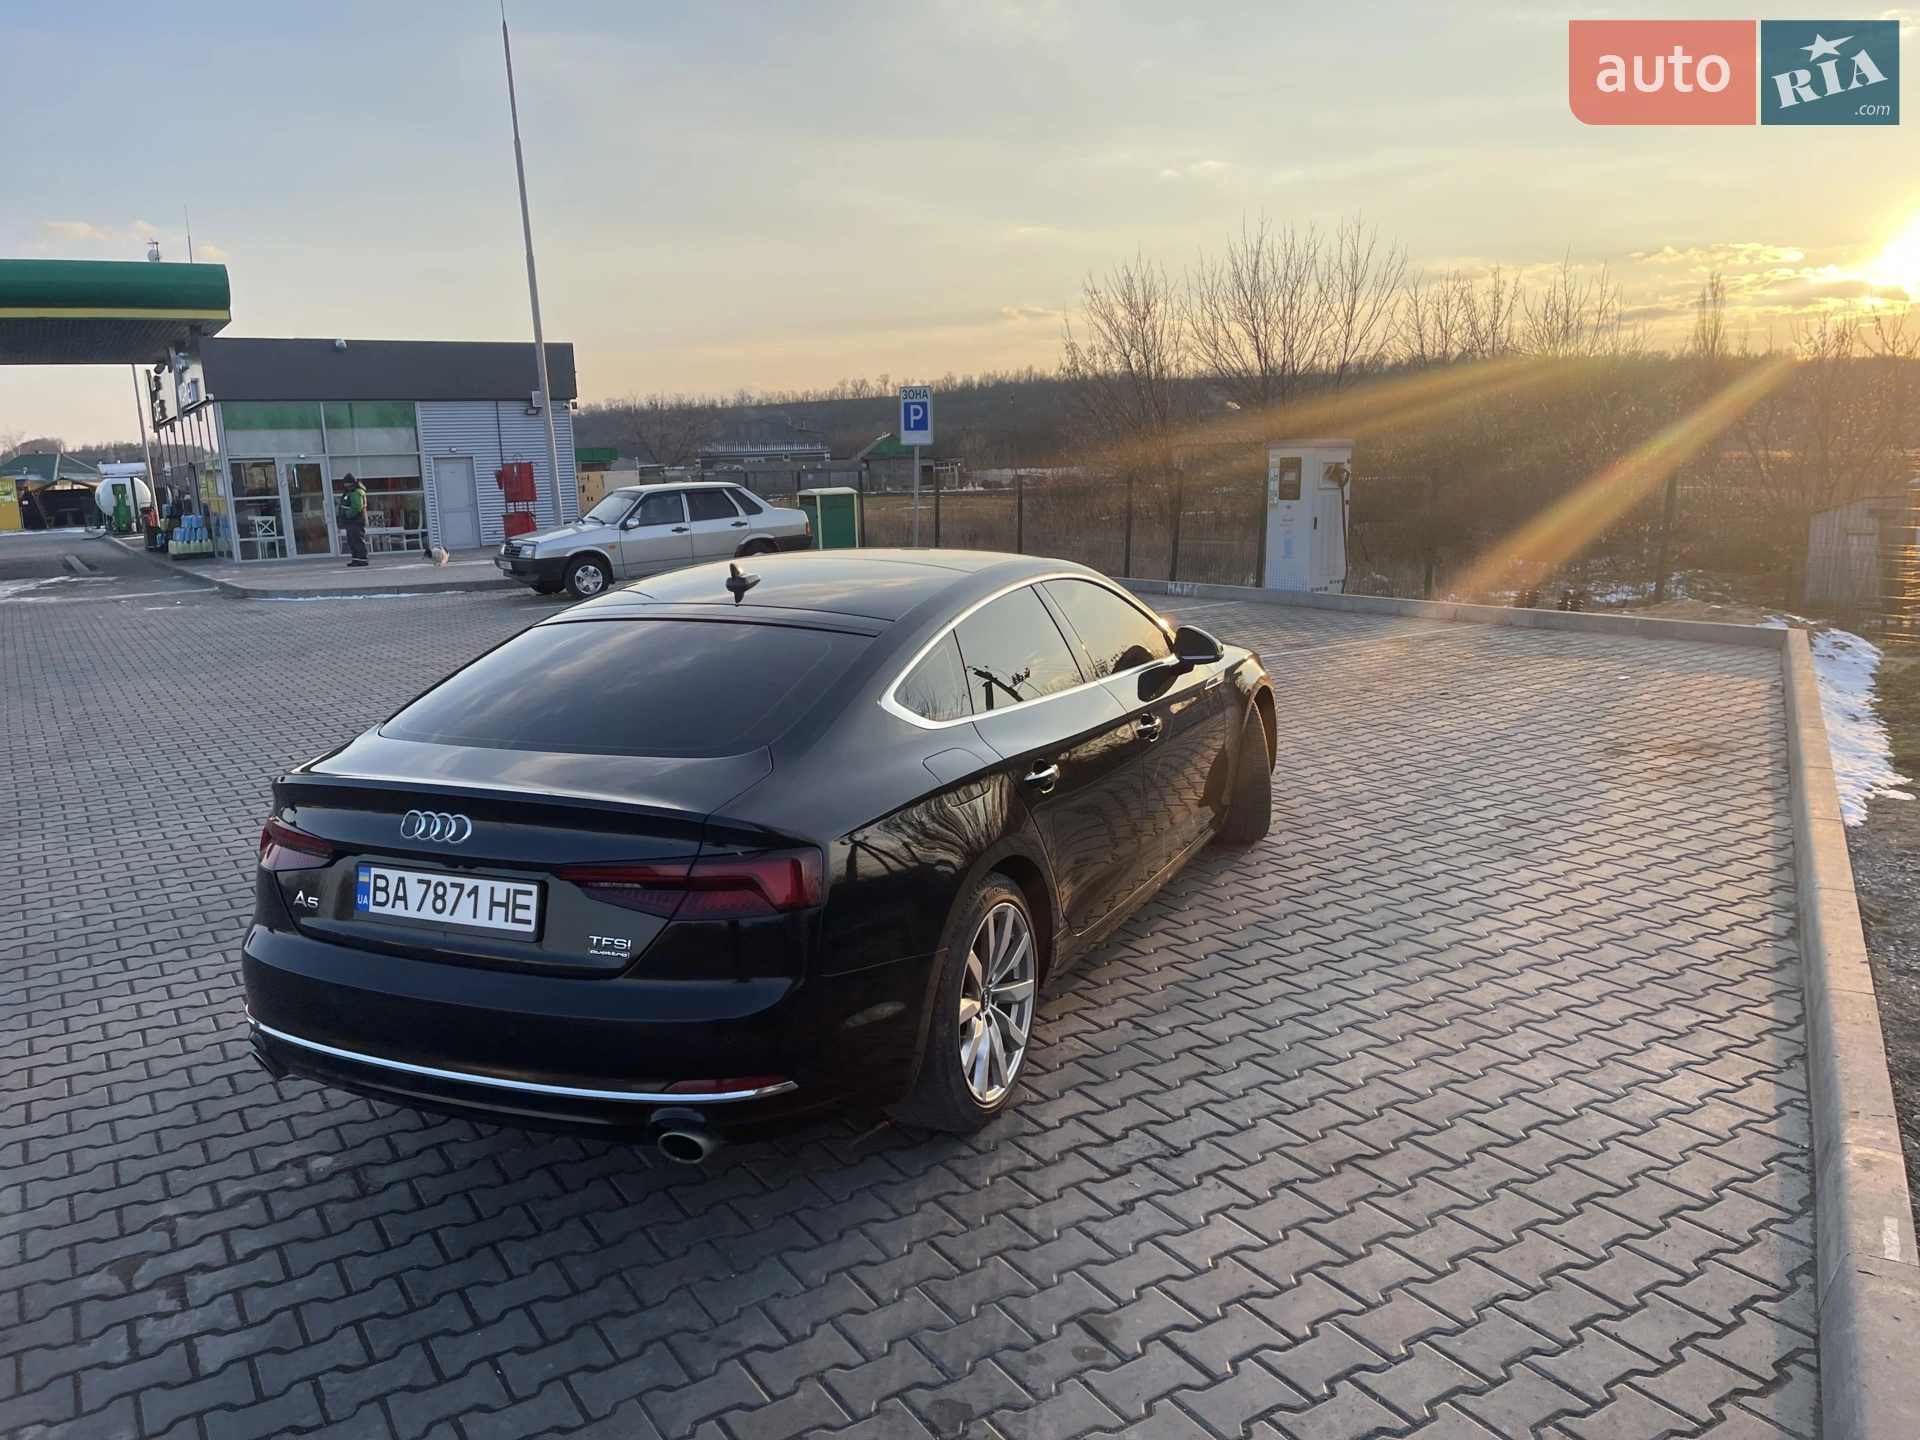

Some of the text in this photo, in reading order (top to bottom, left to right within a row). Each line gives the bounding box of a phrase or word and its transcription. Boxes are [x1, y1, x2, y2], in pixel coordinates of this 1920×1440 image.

[902, 389, 929, 400] ЗОНА
[909, 404, 924, 429] P
[293, 890, 319, 909] A5
[357, 894, 369, 906] UA
[372, 873, 533, 925] BA 7871 HE
[589, 935, 632, 950] TFSI
[589, 949, 628, 958] quattro
